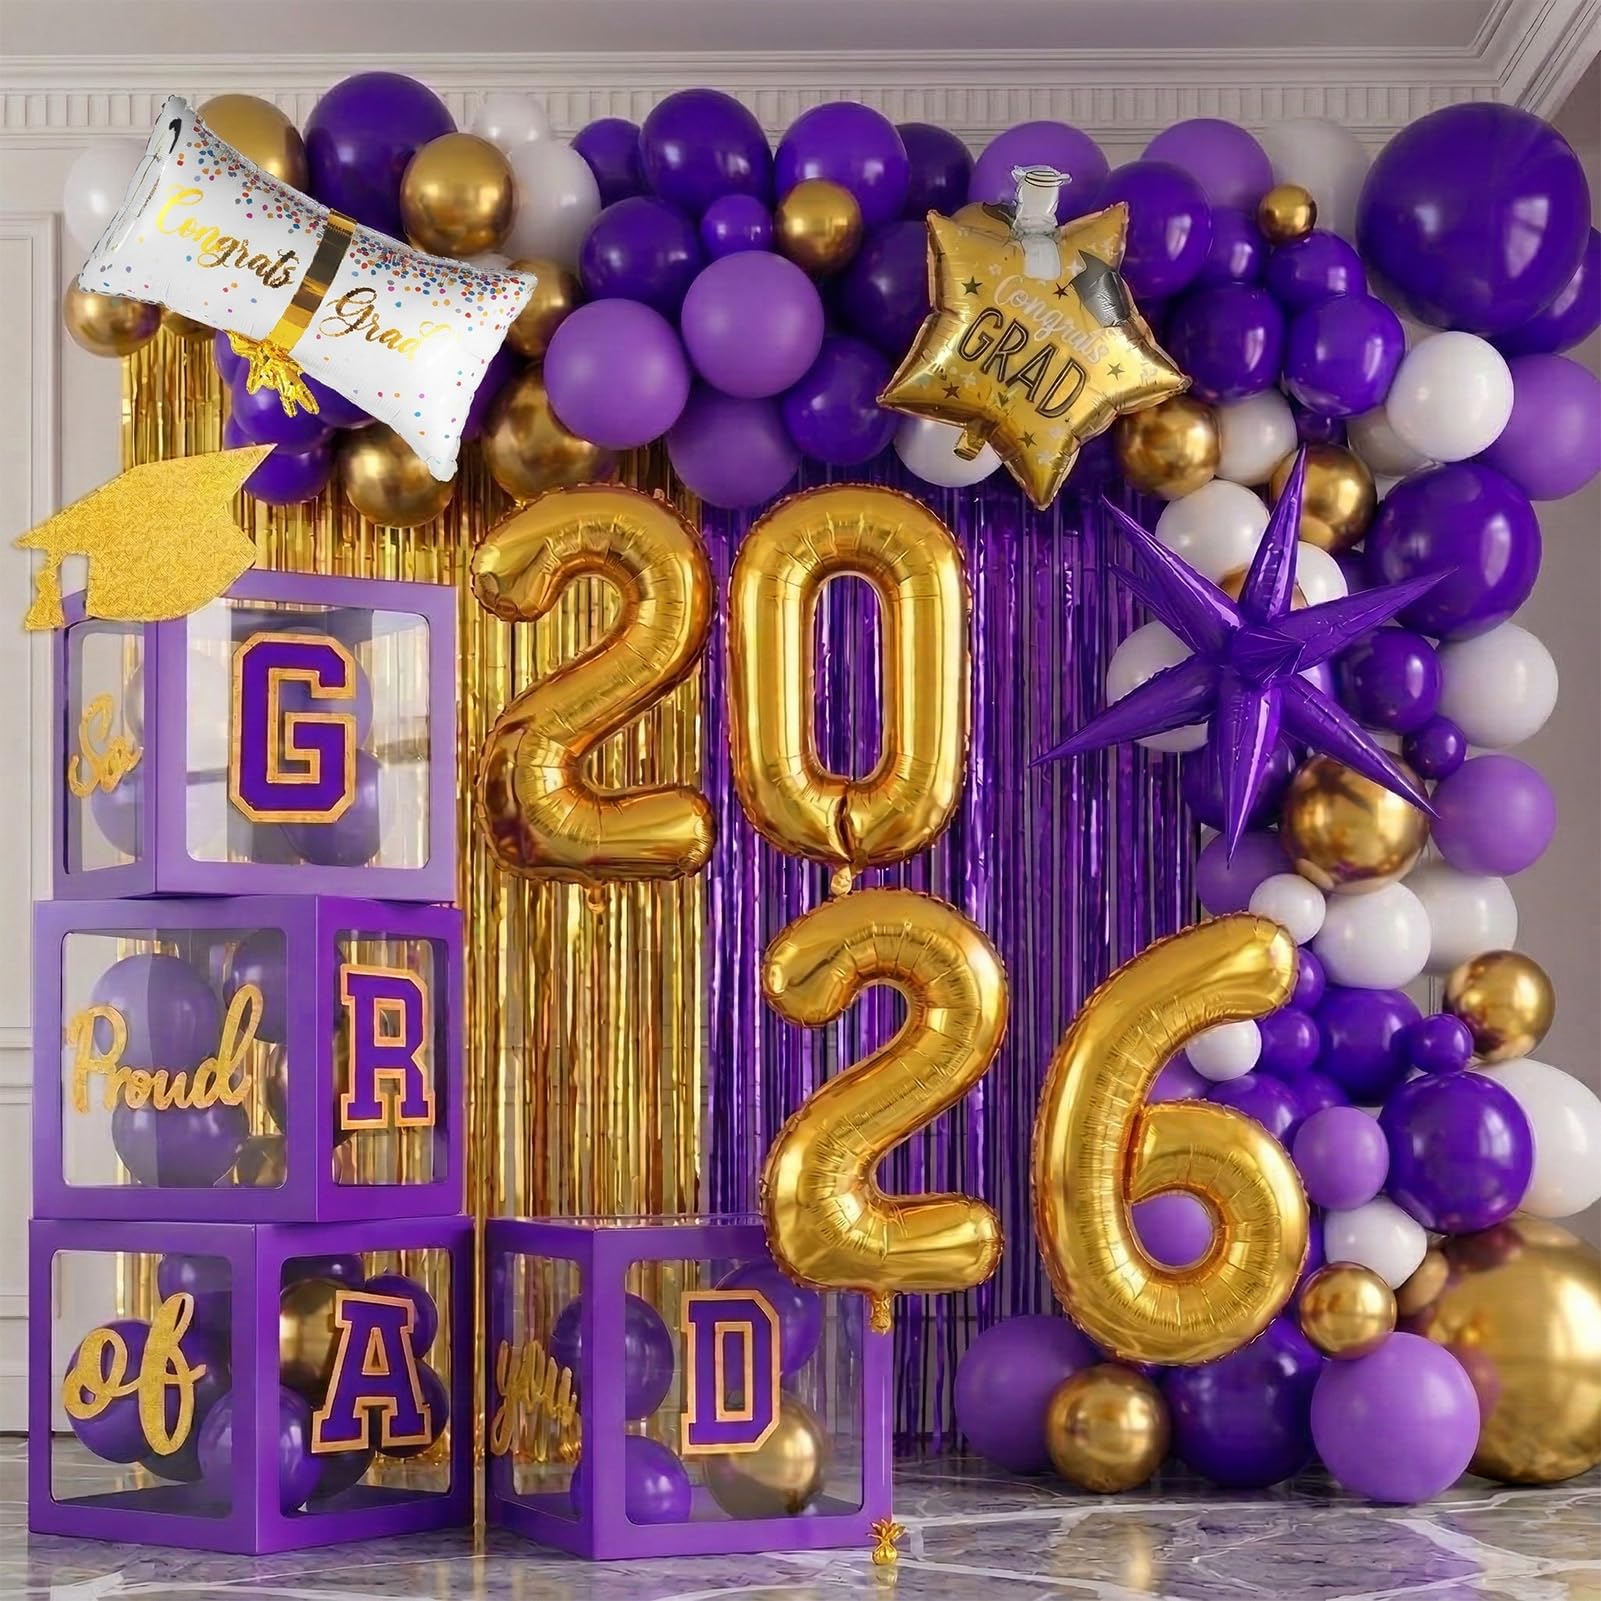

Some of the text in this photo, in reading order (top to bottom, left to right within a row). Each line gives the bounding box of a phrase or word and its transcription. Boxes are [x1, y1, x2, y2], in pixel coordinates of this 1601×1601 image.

[155, 184, 453, 361] Congrats Grad
[994, 274, 1110, 364] Congrats
[958, 307, 1088, 419] GRAD
[68, 694, 144, 798] So
[228, 632, 357, 824] G
[470, 481, 973, 885] 20
[64, 984, 264, 1115] Proud
[340, 963, 436, 1131] R
[760, 888, 1310, 1366] 26
[63, 1292, 206, 1456] of
[311, 1290, 431, 1454] A
[681, 1289, 780, 1455] D
